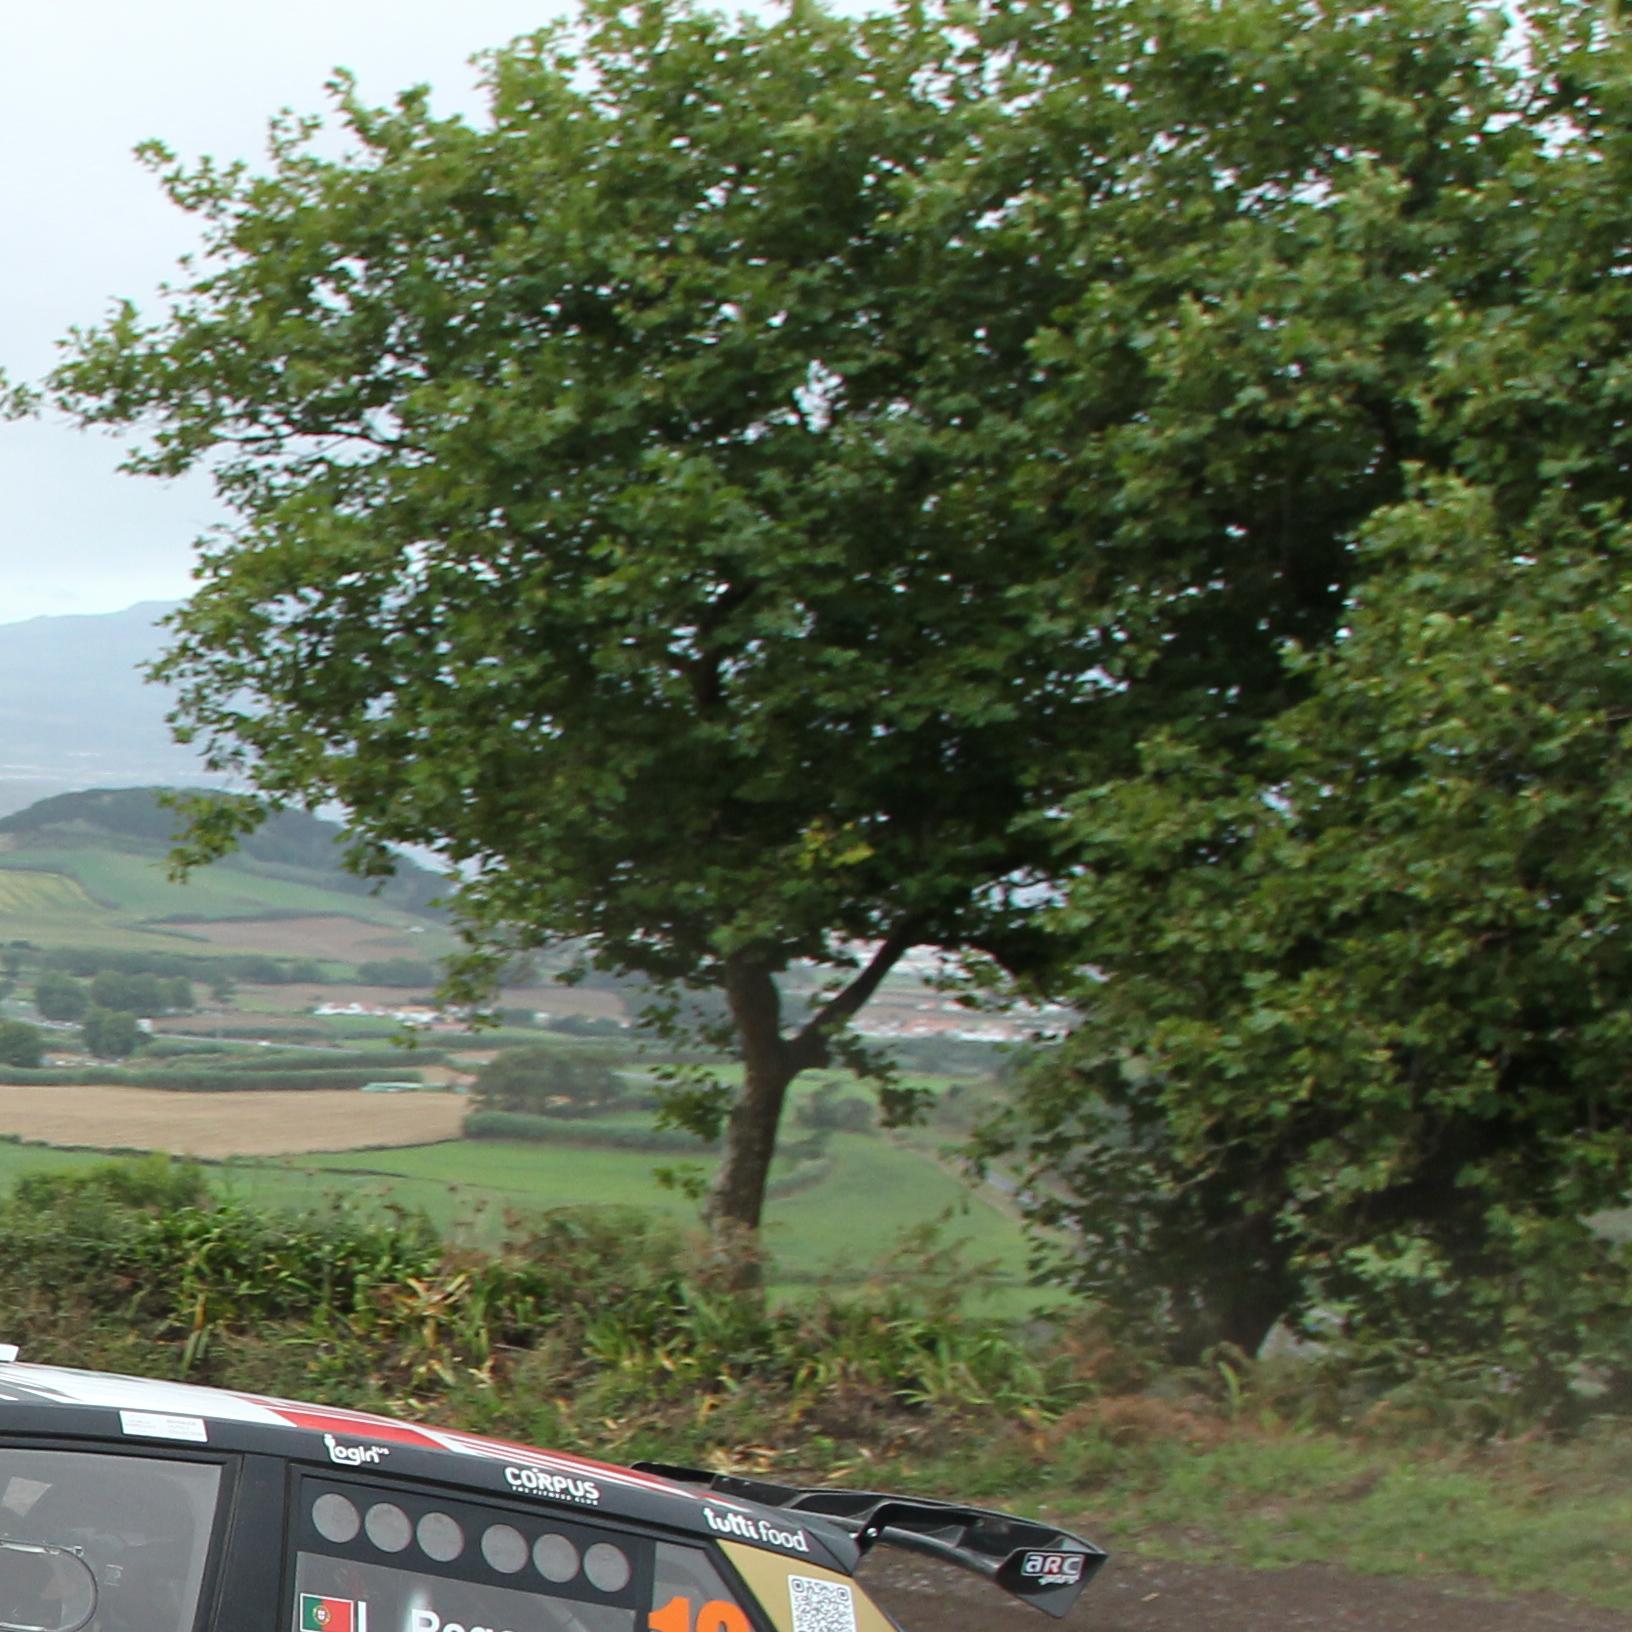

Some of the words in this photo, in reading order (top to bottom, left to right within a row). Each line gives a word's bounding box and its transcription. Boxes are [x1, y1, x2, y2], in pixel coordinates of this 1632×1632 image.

[505, 1467, 600, 1499] CORPUS
[703, 1508, 759, 1539] tutti
[758, 1520, 810, 1552] food
